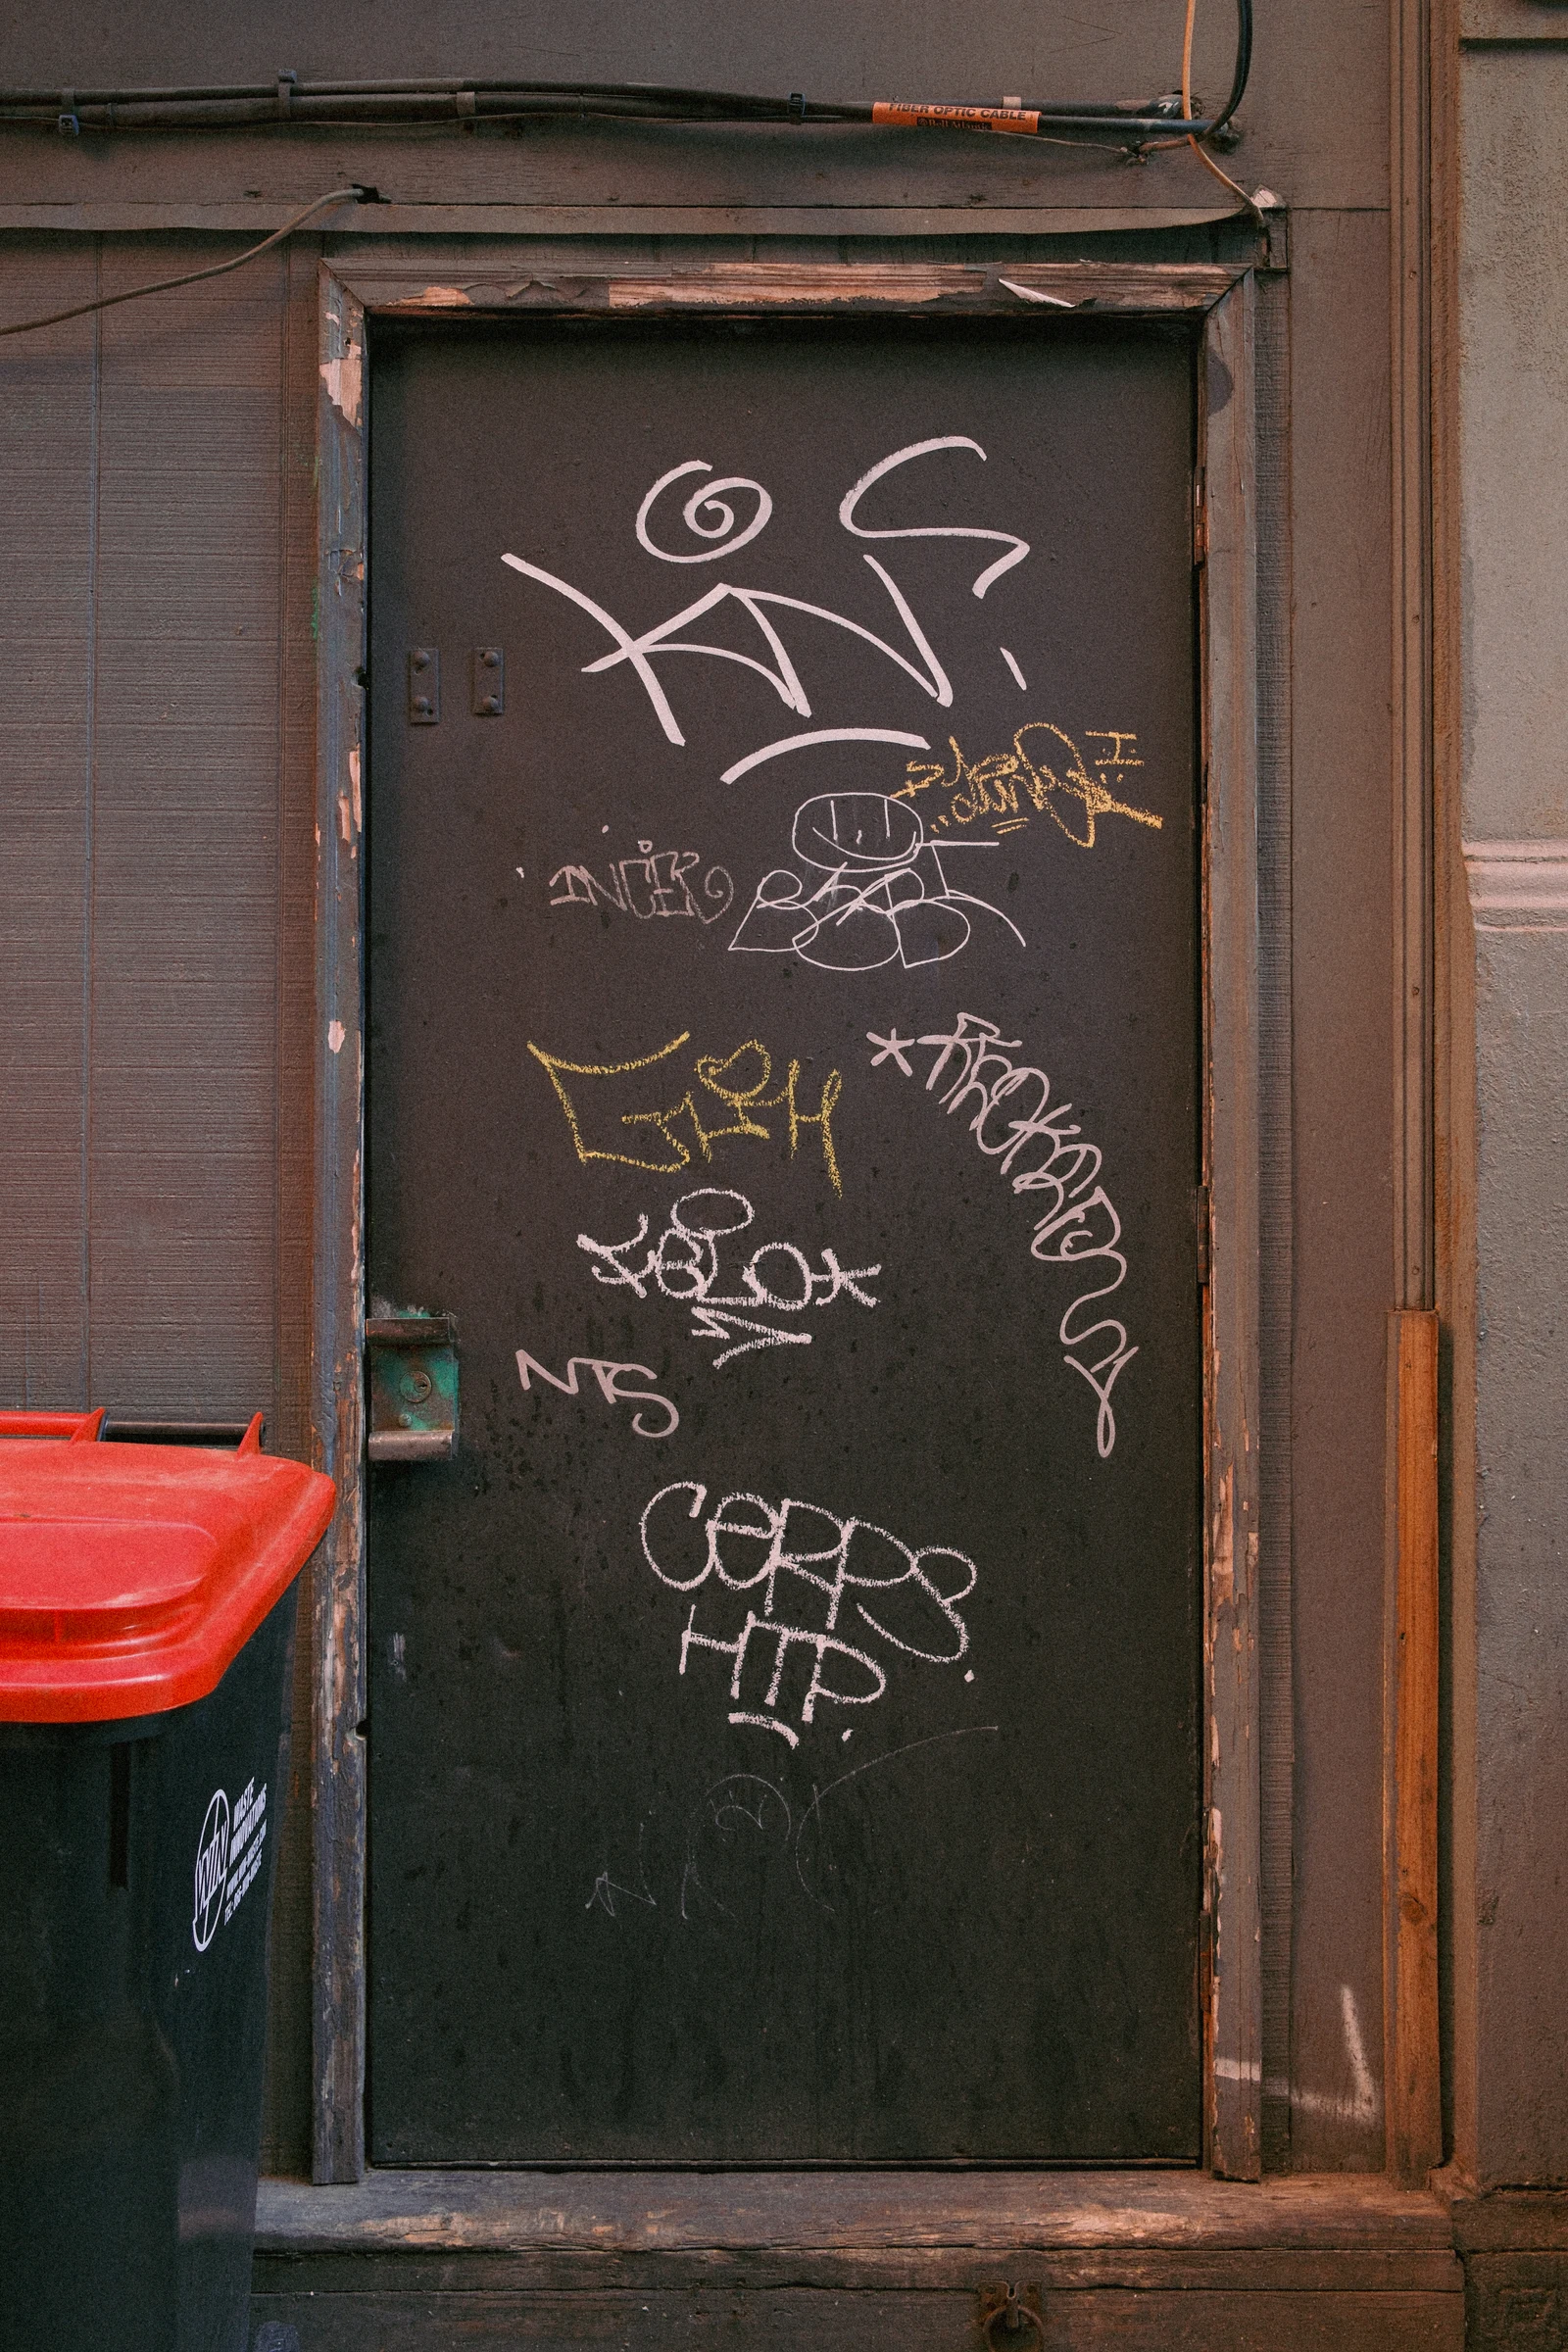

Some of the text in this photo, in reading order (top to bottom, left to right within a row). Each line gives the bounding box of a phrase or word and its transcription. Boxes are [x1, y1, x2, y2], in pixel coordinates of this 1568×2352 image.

[888, 103, 1027, 121] FIBER OPTIC CABLE
[233, 1777, 255, 1832] WASTE
[198, 1820, 228, 1916] WIN
